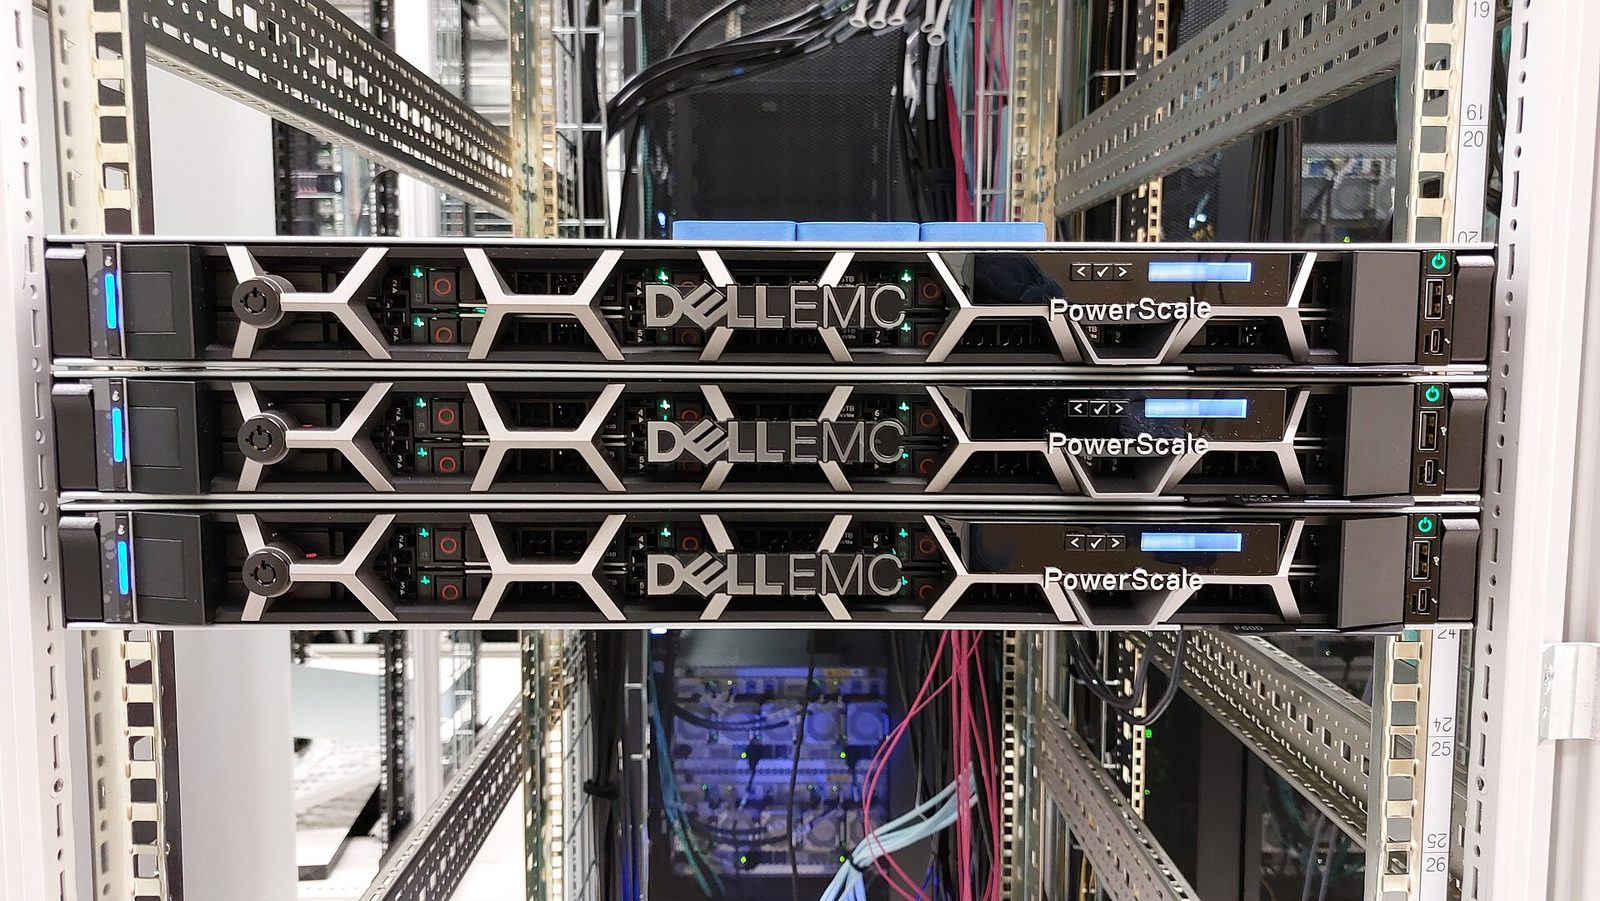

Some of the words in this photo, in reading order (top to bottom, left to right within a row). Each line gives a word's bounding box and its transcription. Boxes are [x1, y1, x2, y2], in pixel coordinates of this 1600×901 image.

[1472, 1, 1490, 18] 19
[1466, 104, 1484, 121] 19
[1463, 131, 1484, 148] 20
[391, 279, 398, 288] 2
[1049, 297, 1212, 322] PowerScale
[393, 328, 399, 336] 3
[637, 329, 643, 337] 5
[396, 407, 402, 415] 2
[874, 409, 880, 417] 6
[1048, 432, 1209, 456] PowerScale
[397, 455, 403, 463] 3
[398, 535, 405, 543] 2
[873, 534, 879, 543] 6
[400, 582, 406, 590] 3
[1044, 567, 1204, 591] PowerScale
[1433, 716, 1452, 733] 24
[1431, 741, 1451, 757] 25
[1427, 833, 1447, 848] 25
[1425, 857, 1446, 873] 26
